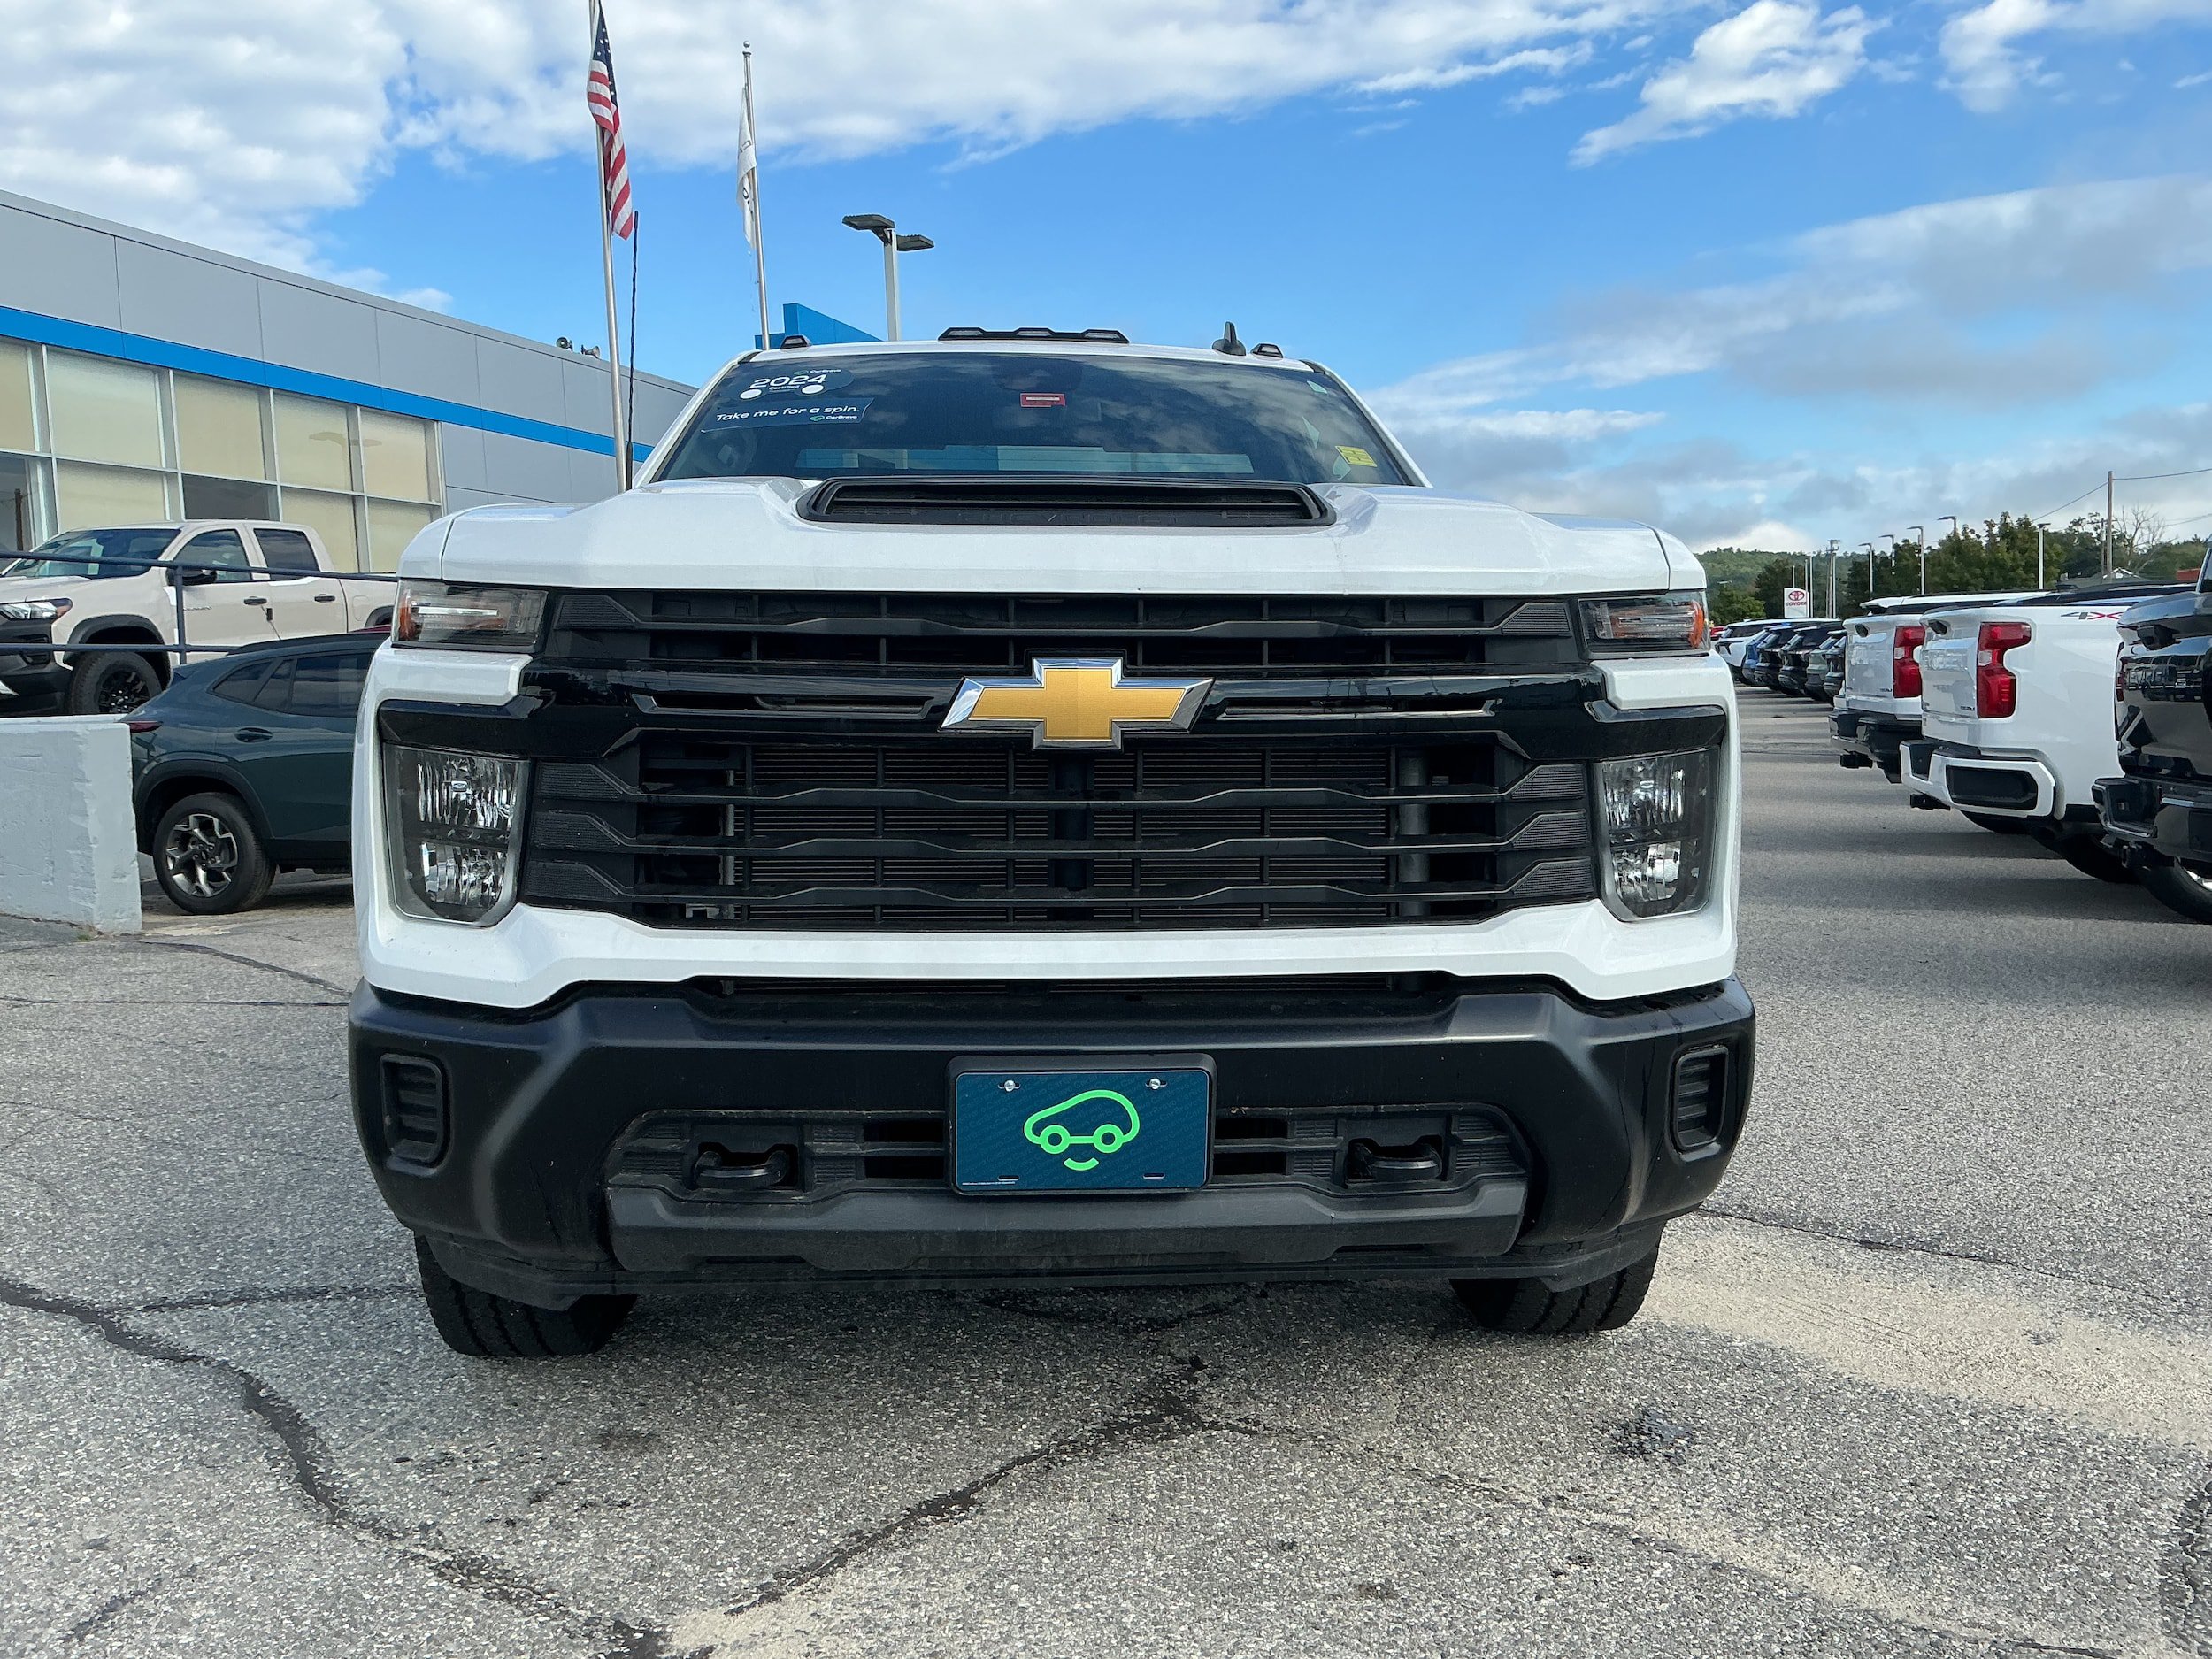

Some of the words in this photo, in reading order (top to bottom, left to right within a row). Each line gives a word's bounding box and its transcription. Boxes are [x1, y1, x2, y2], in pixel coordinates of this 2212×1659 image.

[749, 374, 826, 388] 2024
[717, 412, 749, 422] Take
[824, 405, 860, 414] spin.
